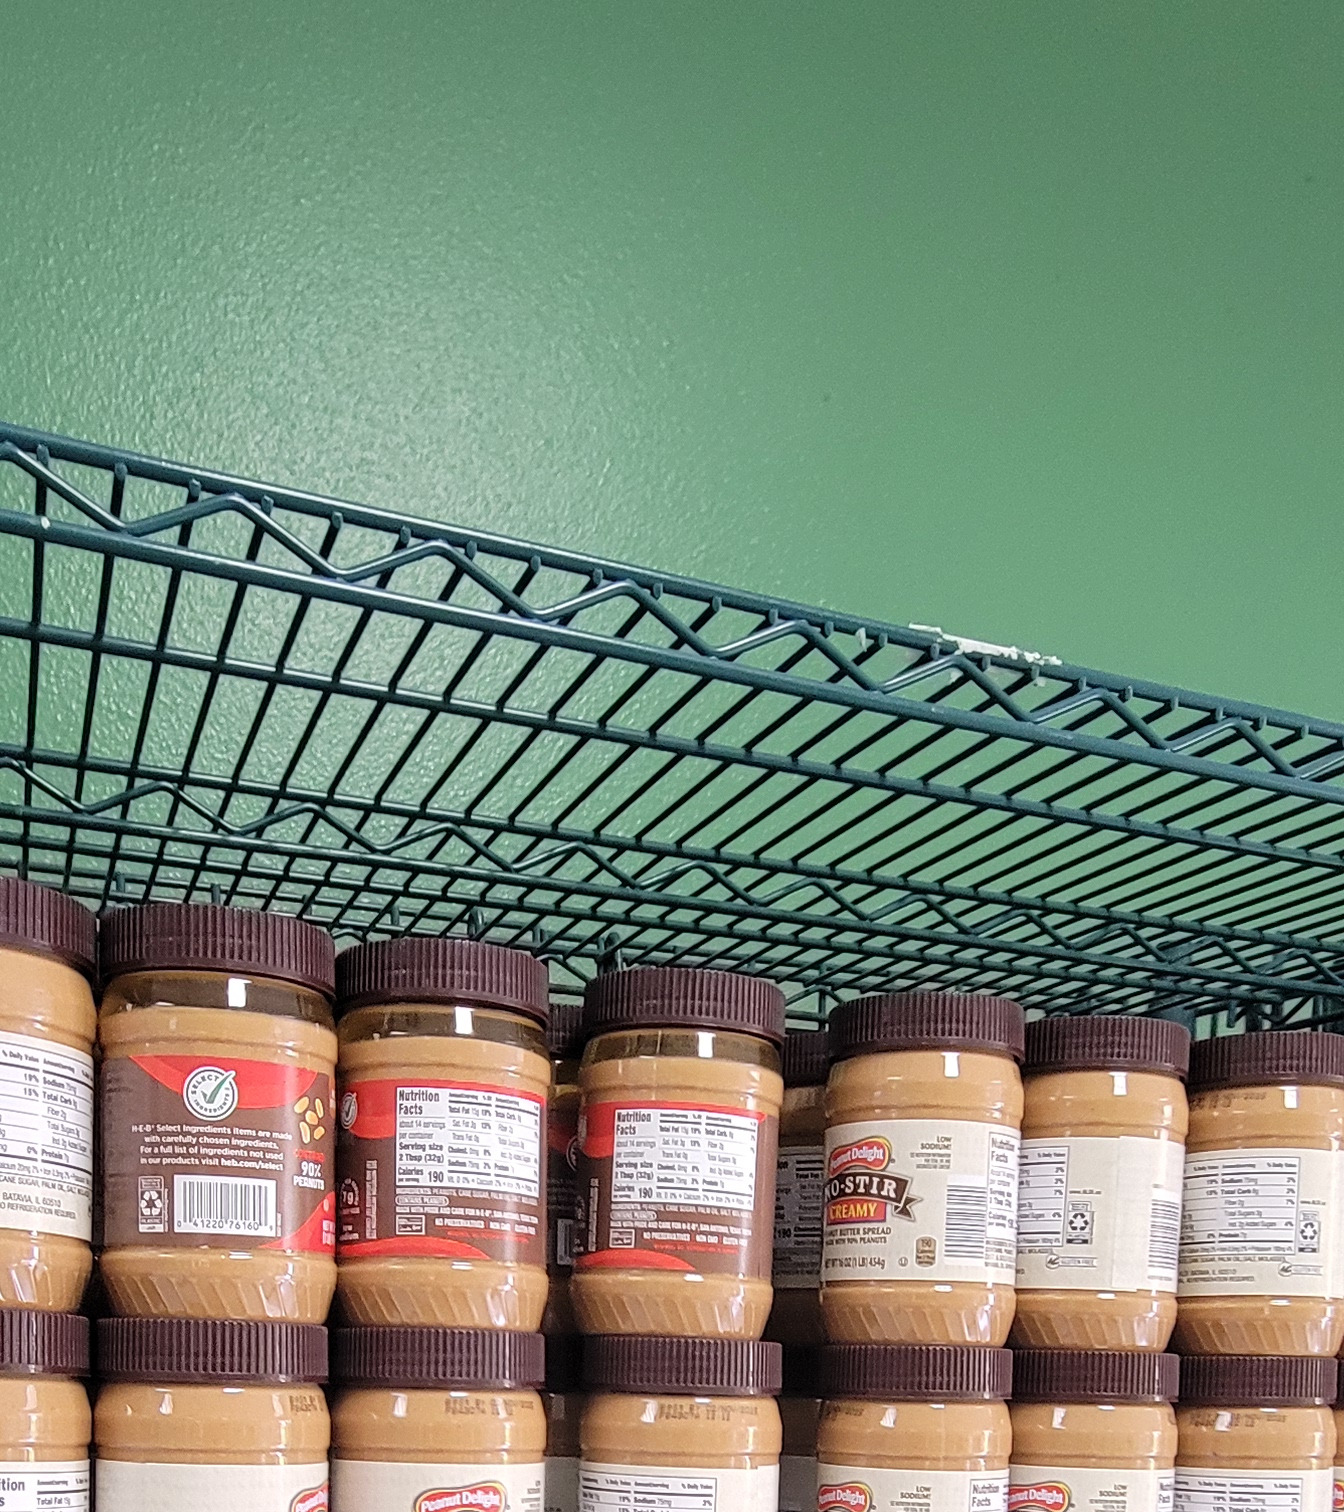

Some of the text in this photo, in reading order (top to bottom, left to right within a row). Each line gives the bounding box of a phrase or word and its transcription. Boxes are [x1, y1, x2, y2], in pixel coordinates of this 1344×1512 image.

[191, 1074, 220, 1094] SELECT
[399, 1090, 439, 1102] Nutrition
[399, 1104, 422, 1115] Facts
[617, 1111, 651, 1122] Nutrition
[183, 1125, 231, 1134] Ingredients
[233, 1127, 256, 1136] items
[273, 1132, 292, 1140] made
[616, 1125, 636, 1135] Facts
[162, 1135, 197, 1145] carefully
[231, 1138, 279, 1149] ingredients.
[160, 1146, 173, 1154] full
[175, 1146, 187, 1154] list
[188, 1146, 198, 1154] of
[200, 1147, 247, 1157] ingredients
[266, 1152, 283, 1160] used
[852, 1146, 883, 1161] Delight
[163, 1157, 199, 1166] products
[221, 1159, 283, 1170] heb.com/select
[302, 1161, 321, 1177] 90%
[294, 1176, 324, 1190] PEANUTS
[428, 1171, 444, 1182] 190
[638, 1188, 652, 1198] 190
[193, 1220, 224, 1228] 41220
[229, 1221, 259, 1230] 76160
[462, 1490, 500, 1508] Delight
[835, 1488, 864, 1505] Delight
[1028, 1487, 1064, 1505] Delight
